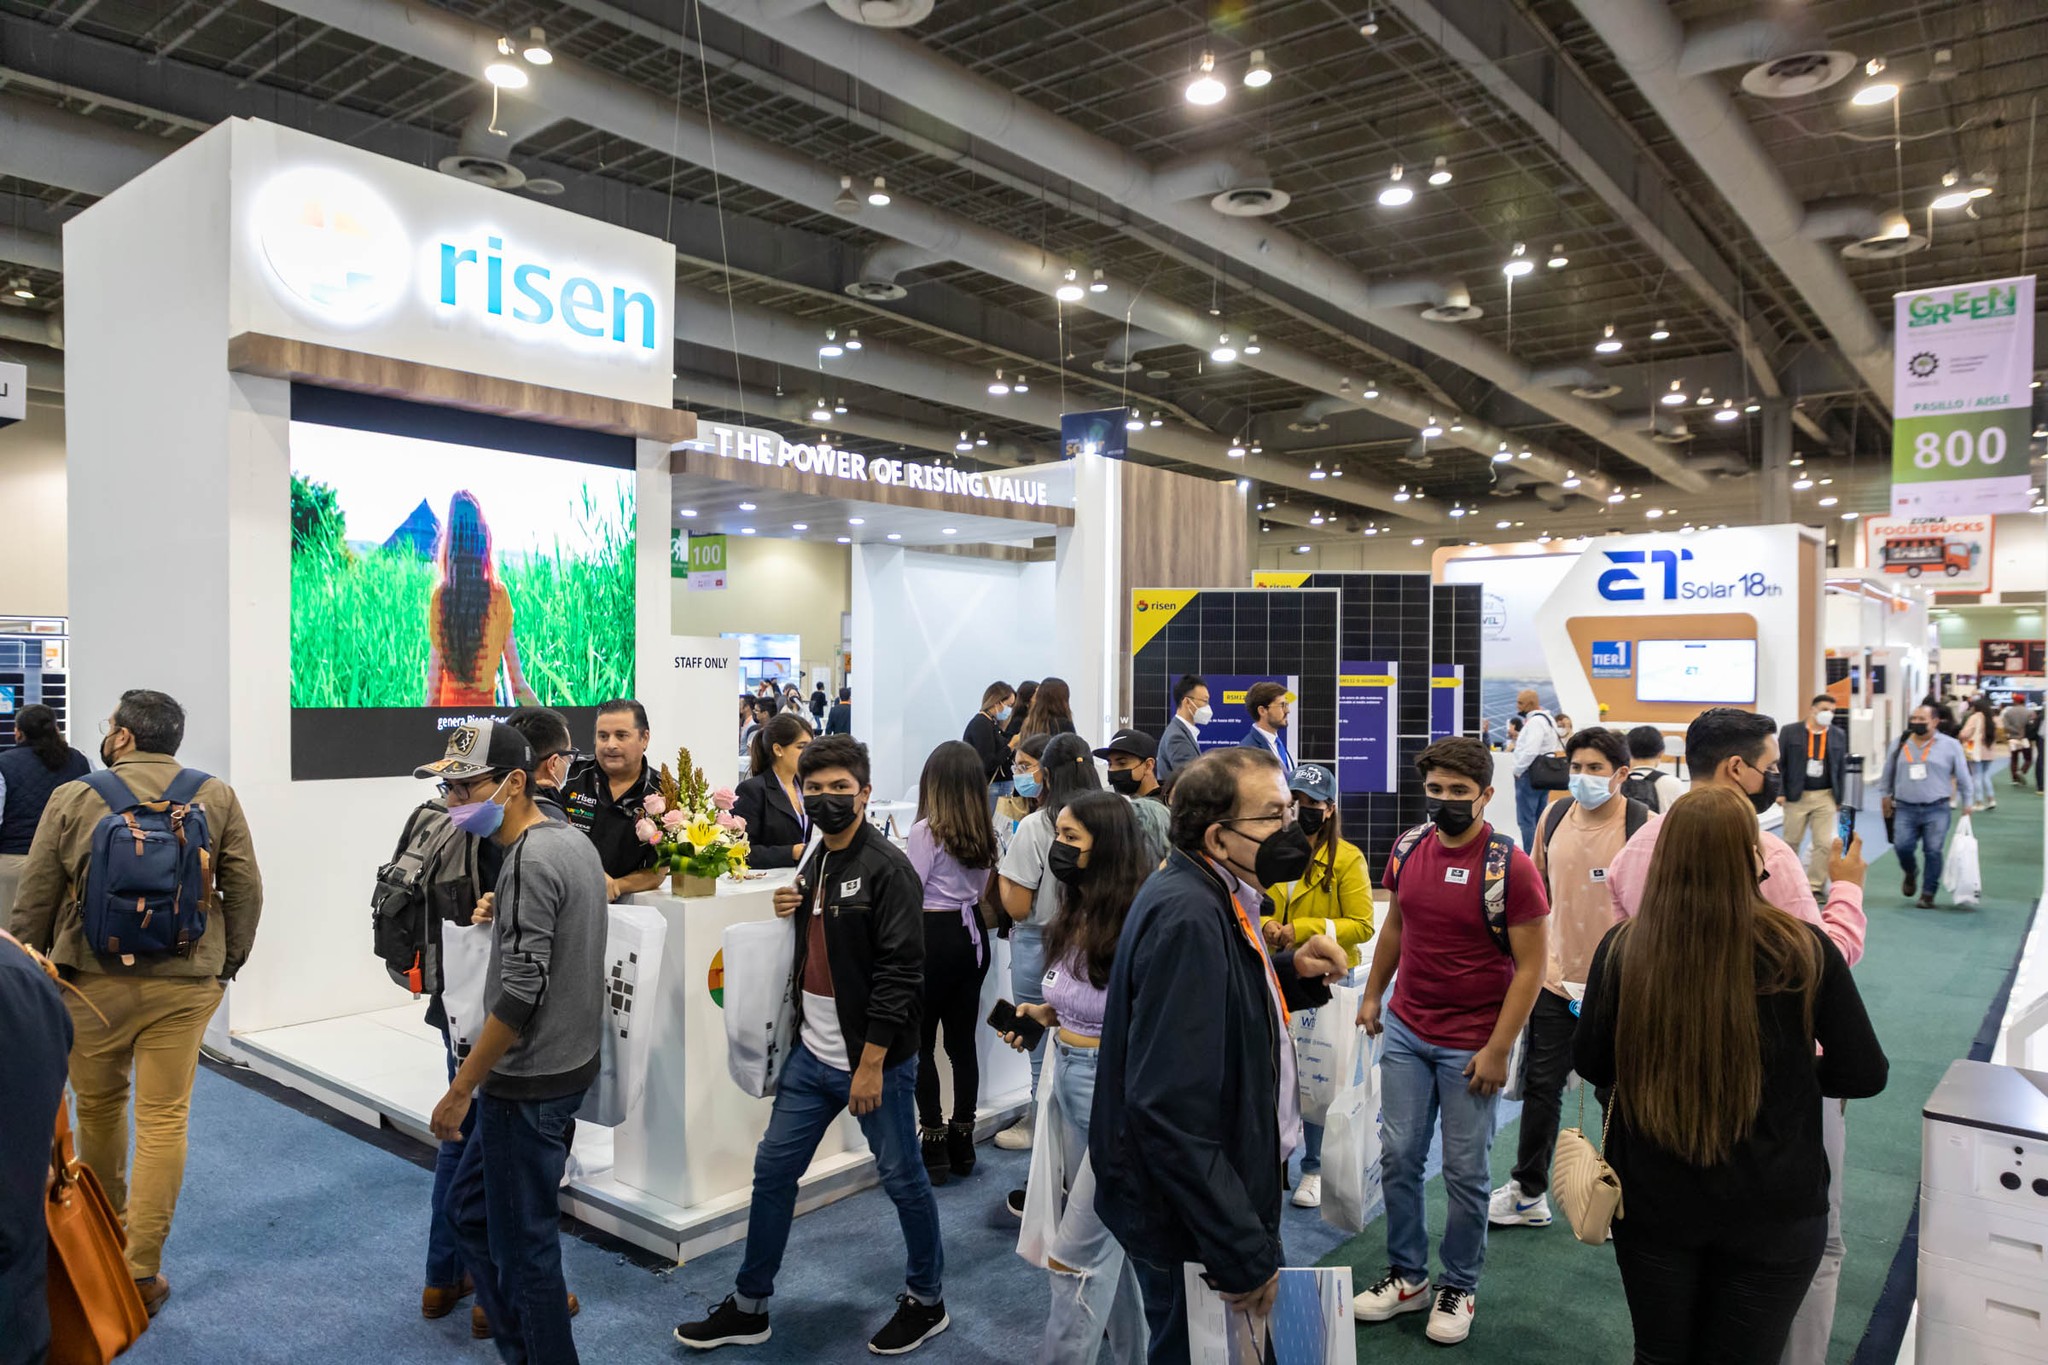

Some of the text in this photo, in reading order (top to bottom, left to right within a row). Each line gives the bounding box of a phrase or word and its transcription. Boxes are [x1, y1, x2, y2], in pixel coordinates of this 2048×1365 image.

[441, 236, 654, 349] risen
[1909, 285, 2016, 323] GREEN
[1975, 393, 2009, 406] AISLE
[1914, 426, 2007, 468] 800
[714, 427, 772, 465] THE
[777, 440, 867, 481] POWER
[873, 457, 902, 485] OF
[988, 475, 1048, 505] VALUE
[694, 544, 720, 565] 100
[1681, 581, 1736, 599] Solar
[1738, 572, 1782, 597] 18th
[1151, 601, 1176, 610] risen
[674, 656, 728, 668] STAFF ONLY
[1592, 641, 1626, 665] TIER 1
[436, 717, 465, 730] genera
[577, 793, 597, 805] risen
